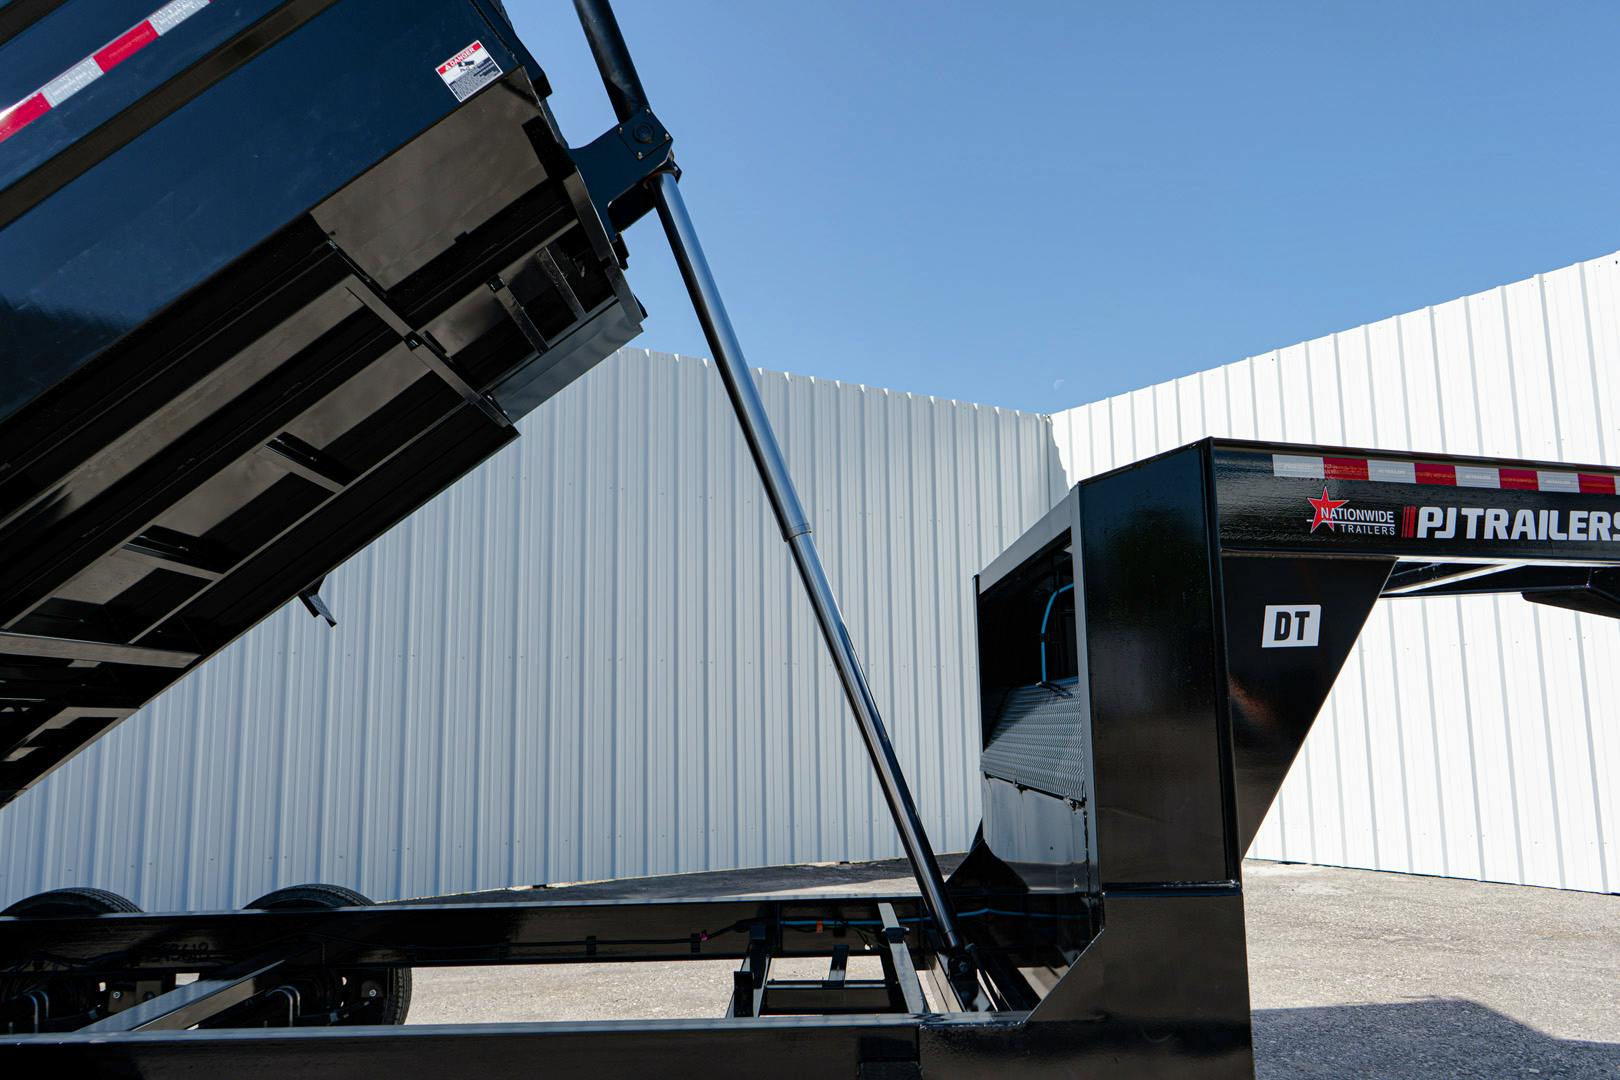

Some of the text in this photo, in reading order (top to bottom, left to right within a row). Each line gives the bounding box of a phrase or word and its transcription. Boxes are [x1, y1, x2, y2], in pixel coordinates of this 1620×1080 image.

[450, 47, 476, 66] DANGER
[1321, 507, 1394, 523] NATIONWIDE
[1417, 506, 1457, 539] PJ
[1341, 525, 1395, 536] TRAILERS
[1274, 611, 1310, 641] DT
